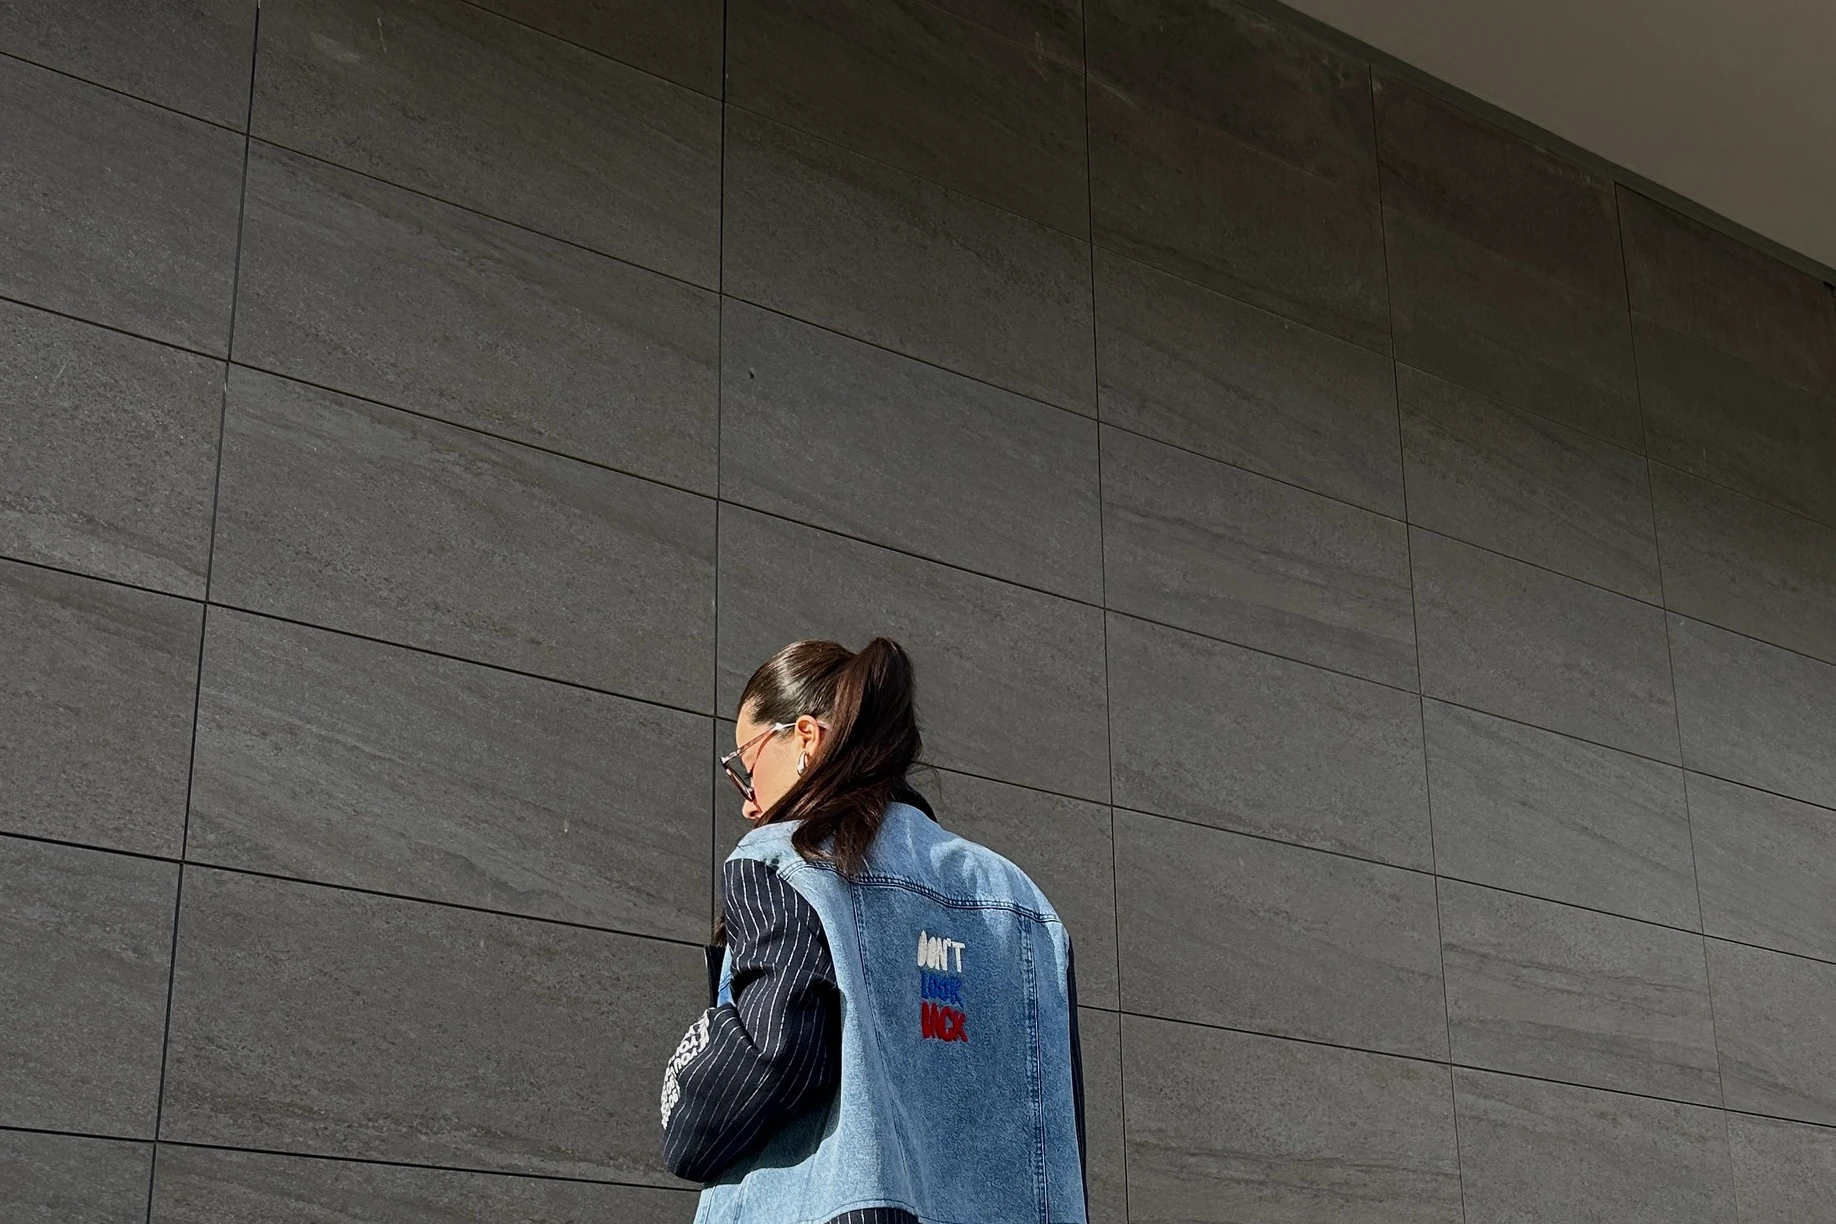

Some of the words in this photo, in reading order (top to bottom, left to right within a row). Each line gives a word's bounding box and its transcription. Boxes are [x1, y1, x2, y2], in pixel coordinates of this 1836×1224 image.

[917, 930, 966, 973] DON'T
[921, 970, 964, 1009] LOOK
[921, 1000, 969, 1042] BACK
